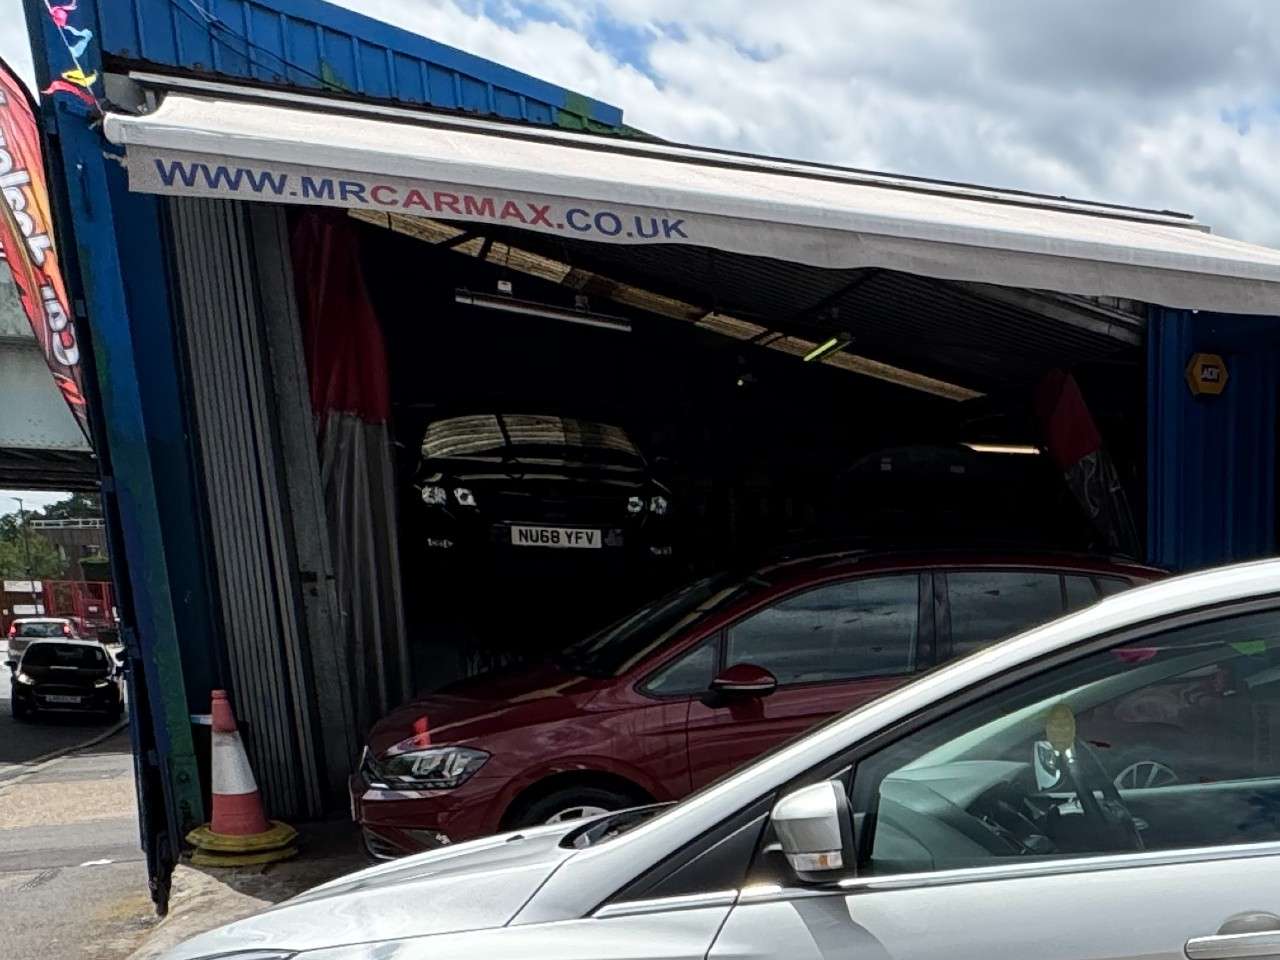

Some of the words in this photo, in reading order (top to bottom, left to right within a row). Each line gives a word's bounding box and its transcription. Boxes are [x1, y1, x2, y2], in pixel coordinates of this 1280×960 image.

[153, 158, 689, 239] WWW.MRCARMAX.CO.UK
[518, 528, 560, 544] NU68
[564, 530, 594, 545] YFV
